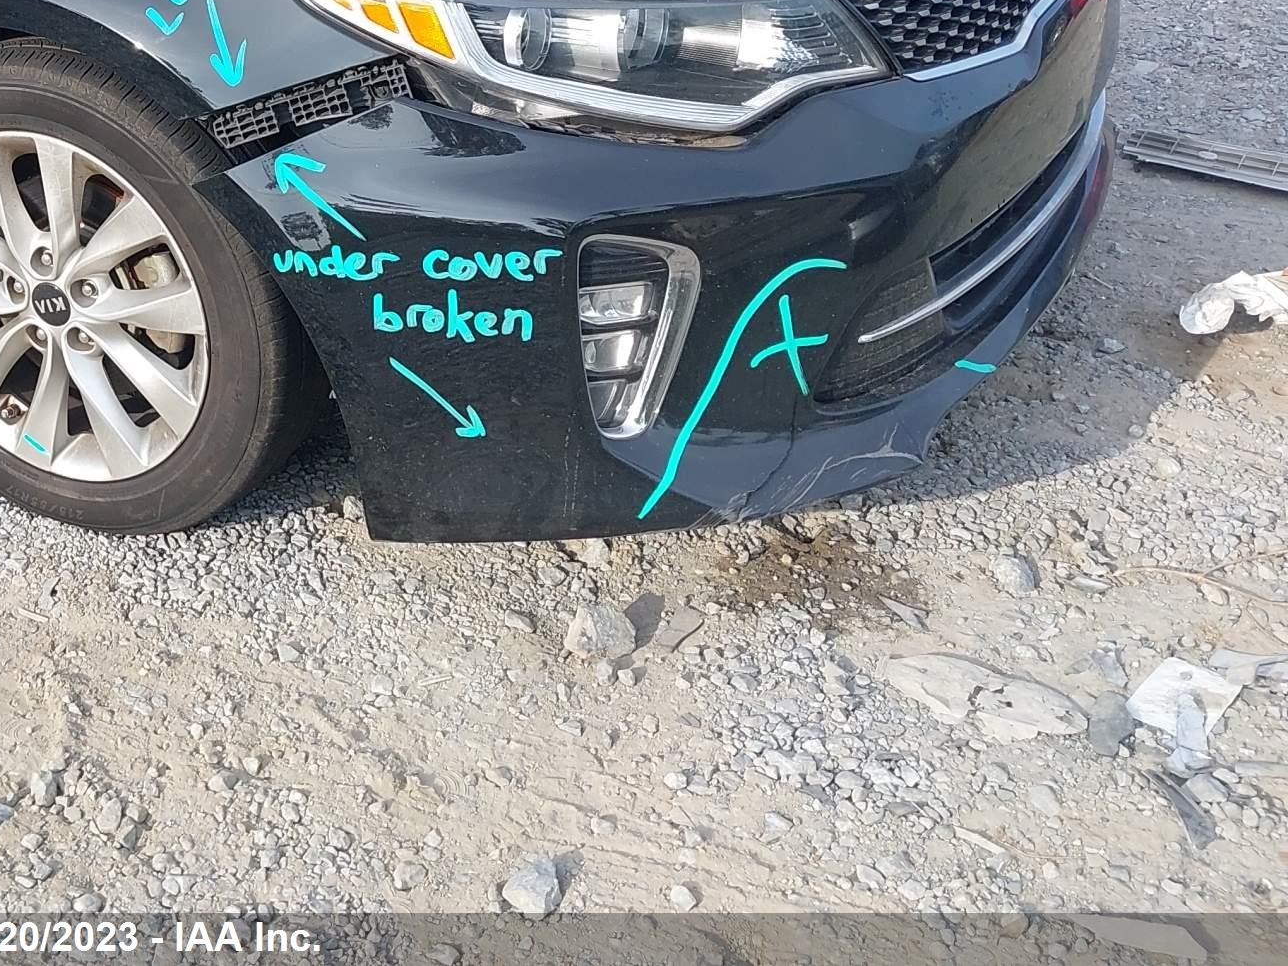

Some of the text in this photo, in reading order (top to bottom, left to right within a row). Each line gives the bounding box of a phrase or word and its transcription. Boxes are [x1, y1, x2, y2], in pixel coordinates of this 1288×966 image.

[273, 245, 562, 283] under cover
[35, 295, 68, 315] KIA
[373, 288, 534, 344] broken
